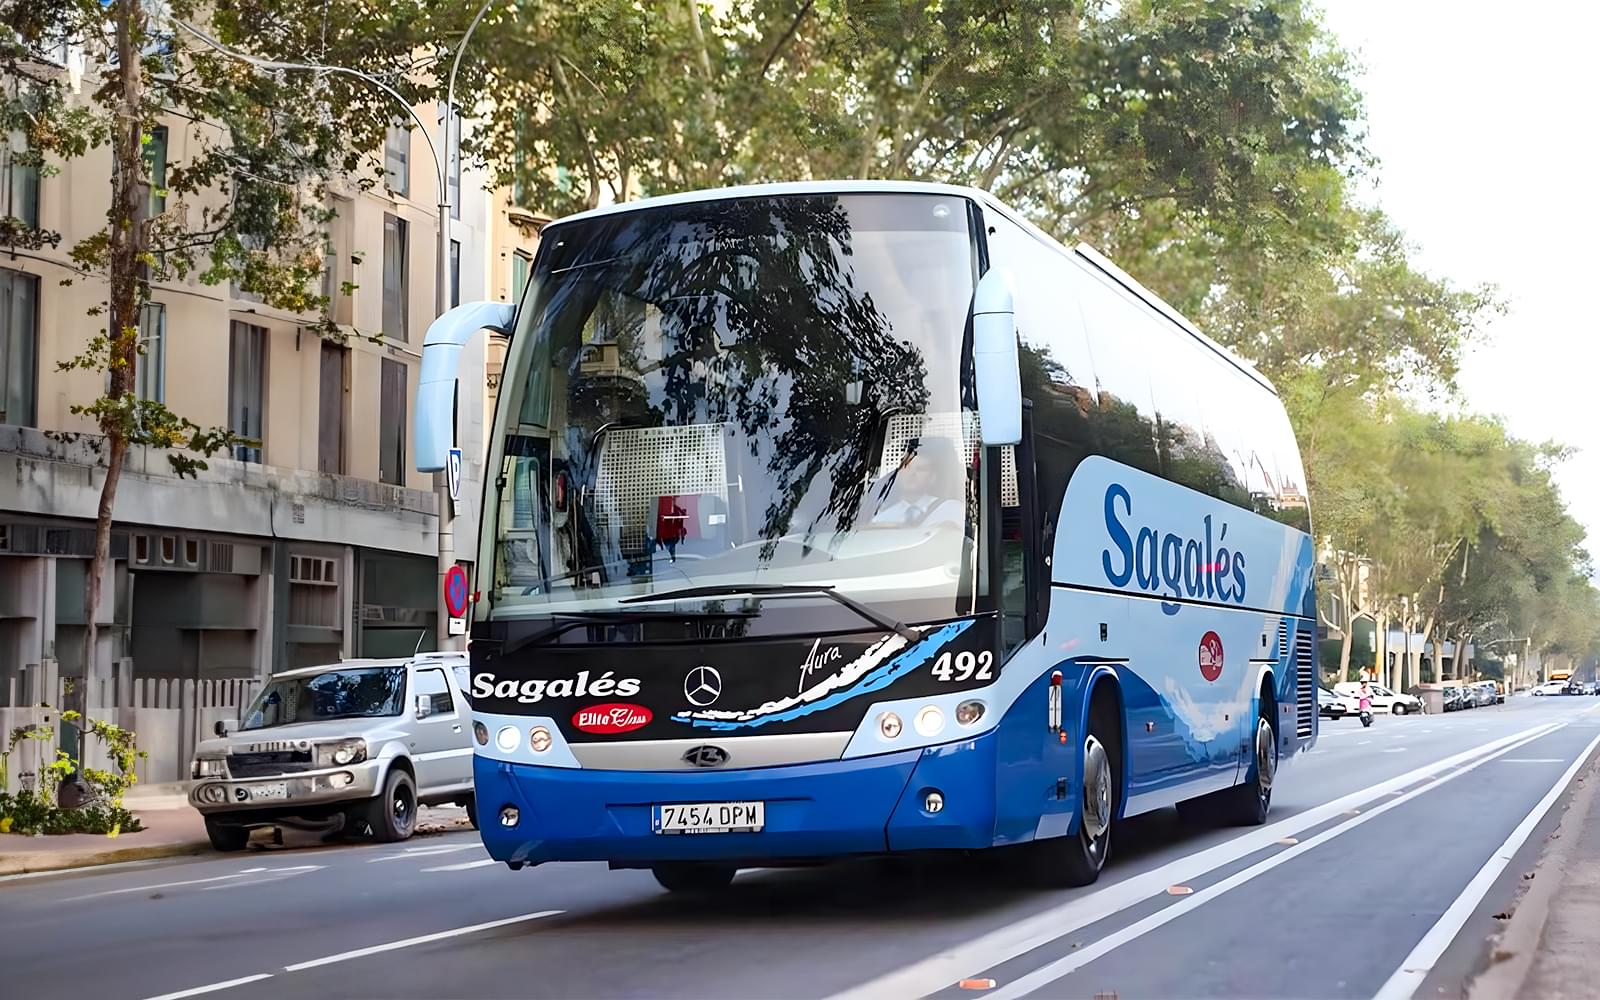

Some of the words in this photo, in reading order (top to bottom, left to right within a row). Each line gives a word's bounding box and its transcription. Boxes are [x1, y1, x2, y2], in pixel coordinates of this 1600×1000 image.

[1102, 483, 1246, 616] Sagalés
[799, 637, 842, 693] Aura
[931, 650, 993, 682] 492
[471, 670, 642, 704] Sagalés
[664, 806, 713, 828] 7454
[720, 805, 757, 826] DPM
